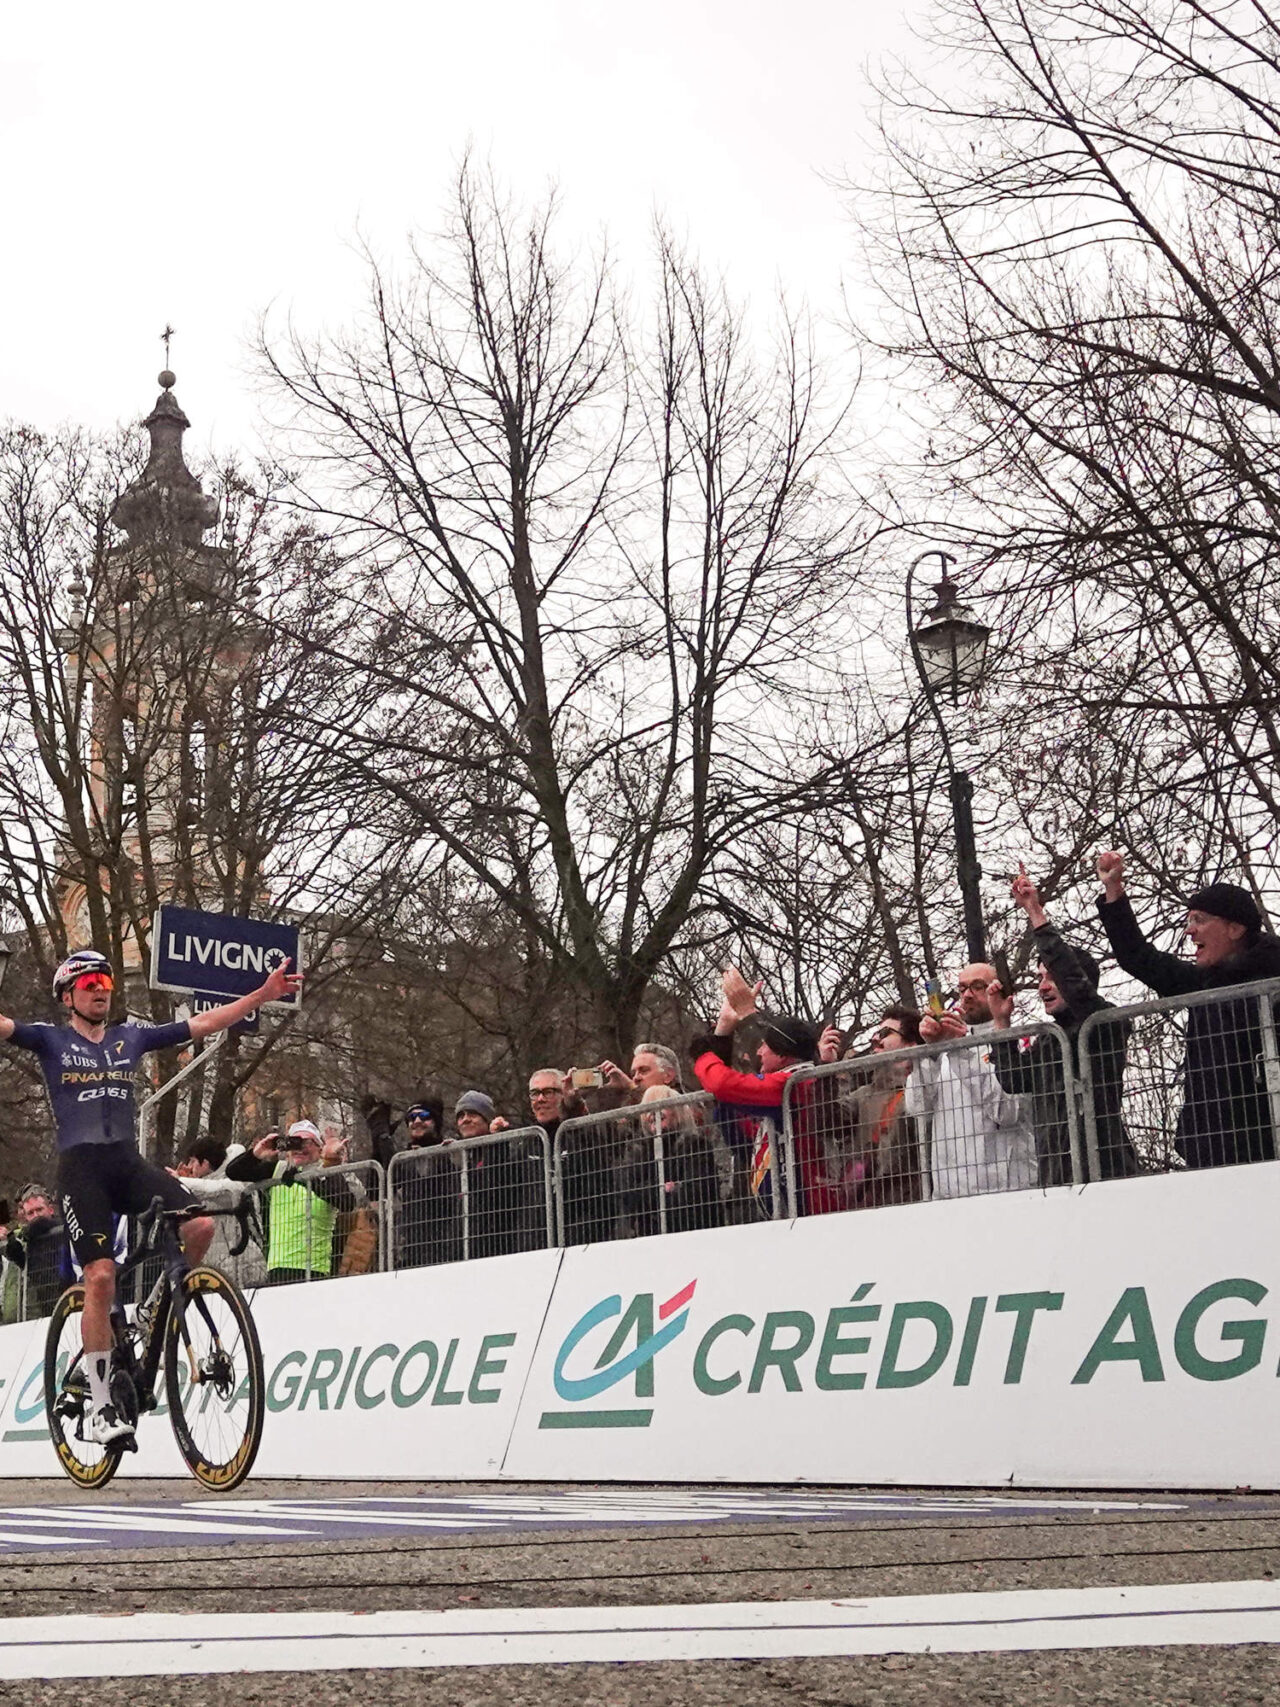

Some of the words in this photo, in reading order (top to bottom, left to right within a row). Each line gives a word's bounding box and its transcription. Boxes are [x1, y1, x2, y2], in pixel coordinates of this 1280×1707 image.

[168, 933, 287, 974] LIVIGNO
[72, 1055, 98, 1068] UBS
[65, 1208, 84, 1242] UBS
[692, 1282, 1065, 1397] CRÉDIT
